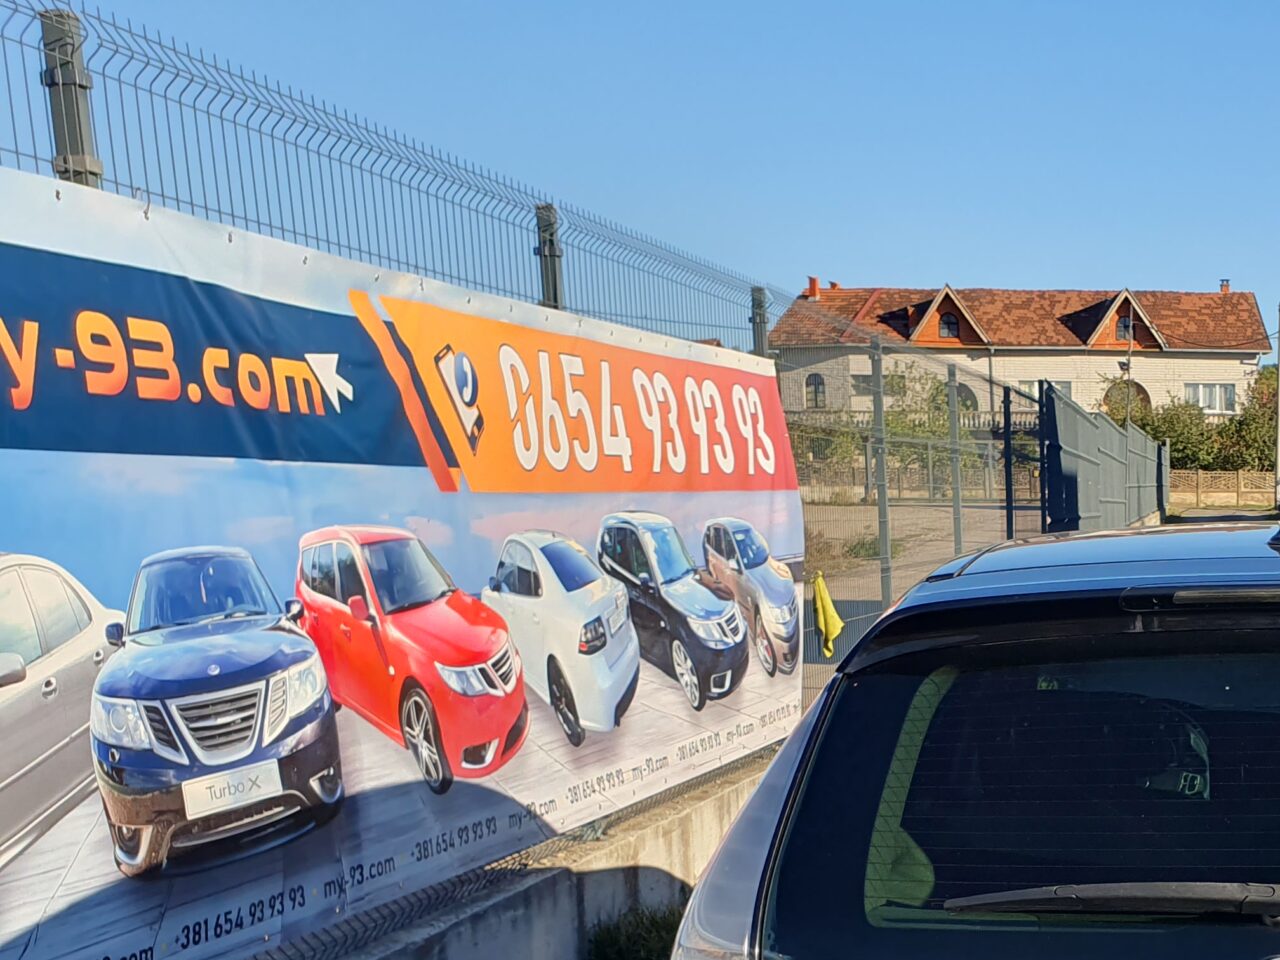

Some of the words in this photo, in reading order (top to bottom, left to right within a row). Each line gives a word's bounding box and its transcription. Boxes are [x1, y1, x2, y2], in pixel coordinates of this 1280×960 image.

[498, 343, 633, 473] 0654
[631, 367, 687, 474] 93
[684, 376, 735, 475] 93
[731, 384, 776, 475] 93
[205, 781, 245, 801] Turbo
[248, 775, 262, 792] X
[214, 906, 244, 939] 654
[249, 902, 265, 926] 93
[269, 892, 284, 918] 93
[288, 885, 306, 911] 93
[323, 856, 396, 899] my-93.com
[435, 832, 456, 856] 654
[457, 825, 470, 847] 93
[472, 820, 484, 842] 93
[485, 815, 497, 836] 93
[508, 798, 558, 829] my-93.com
